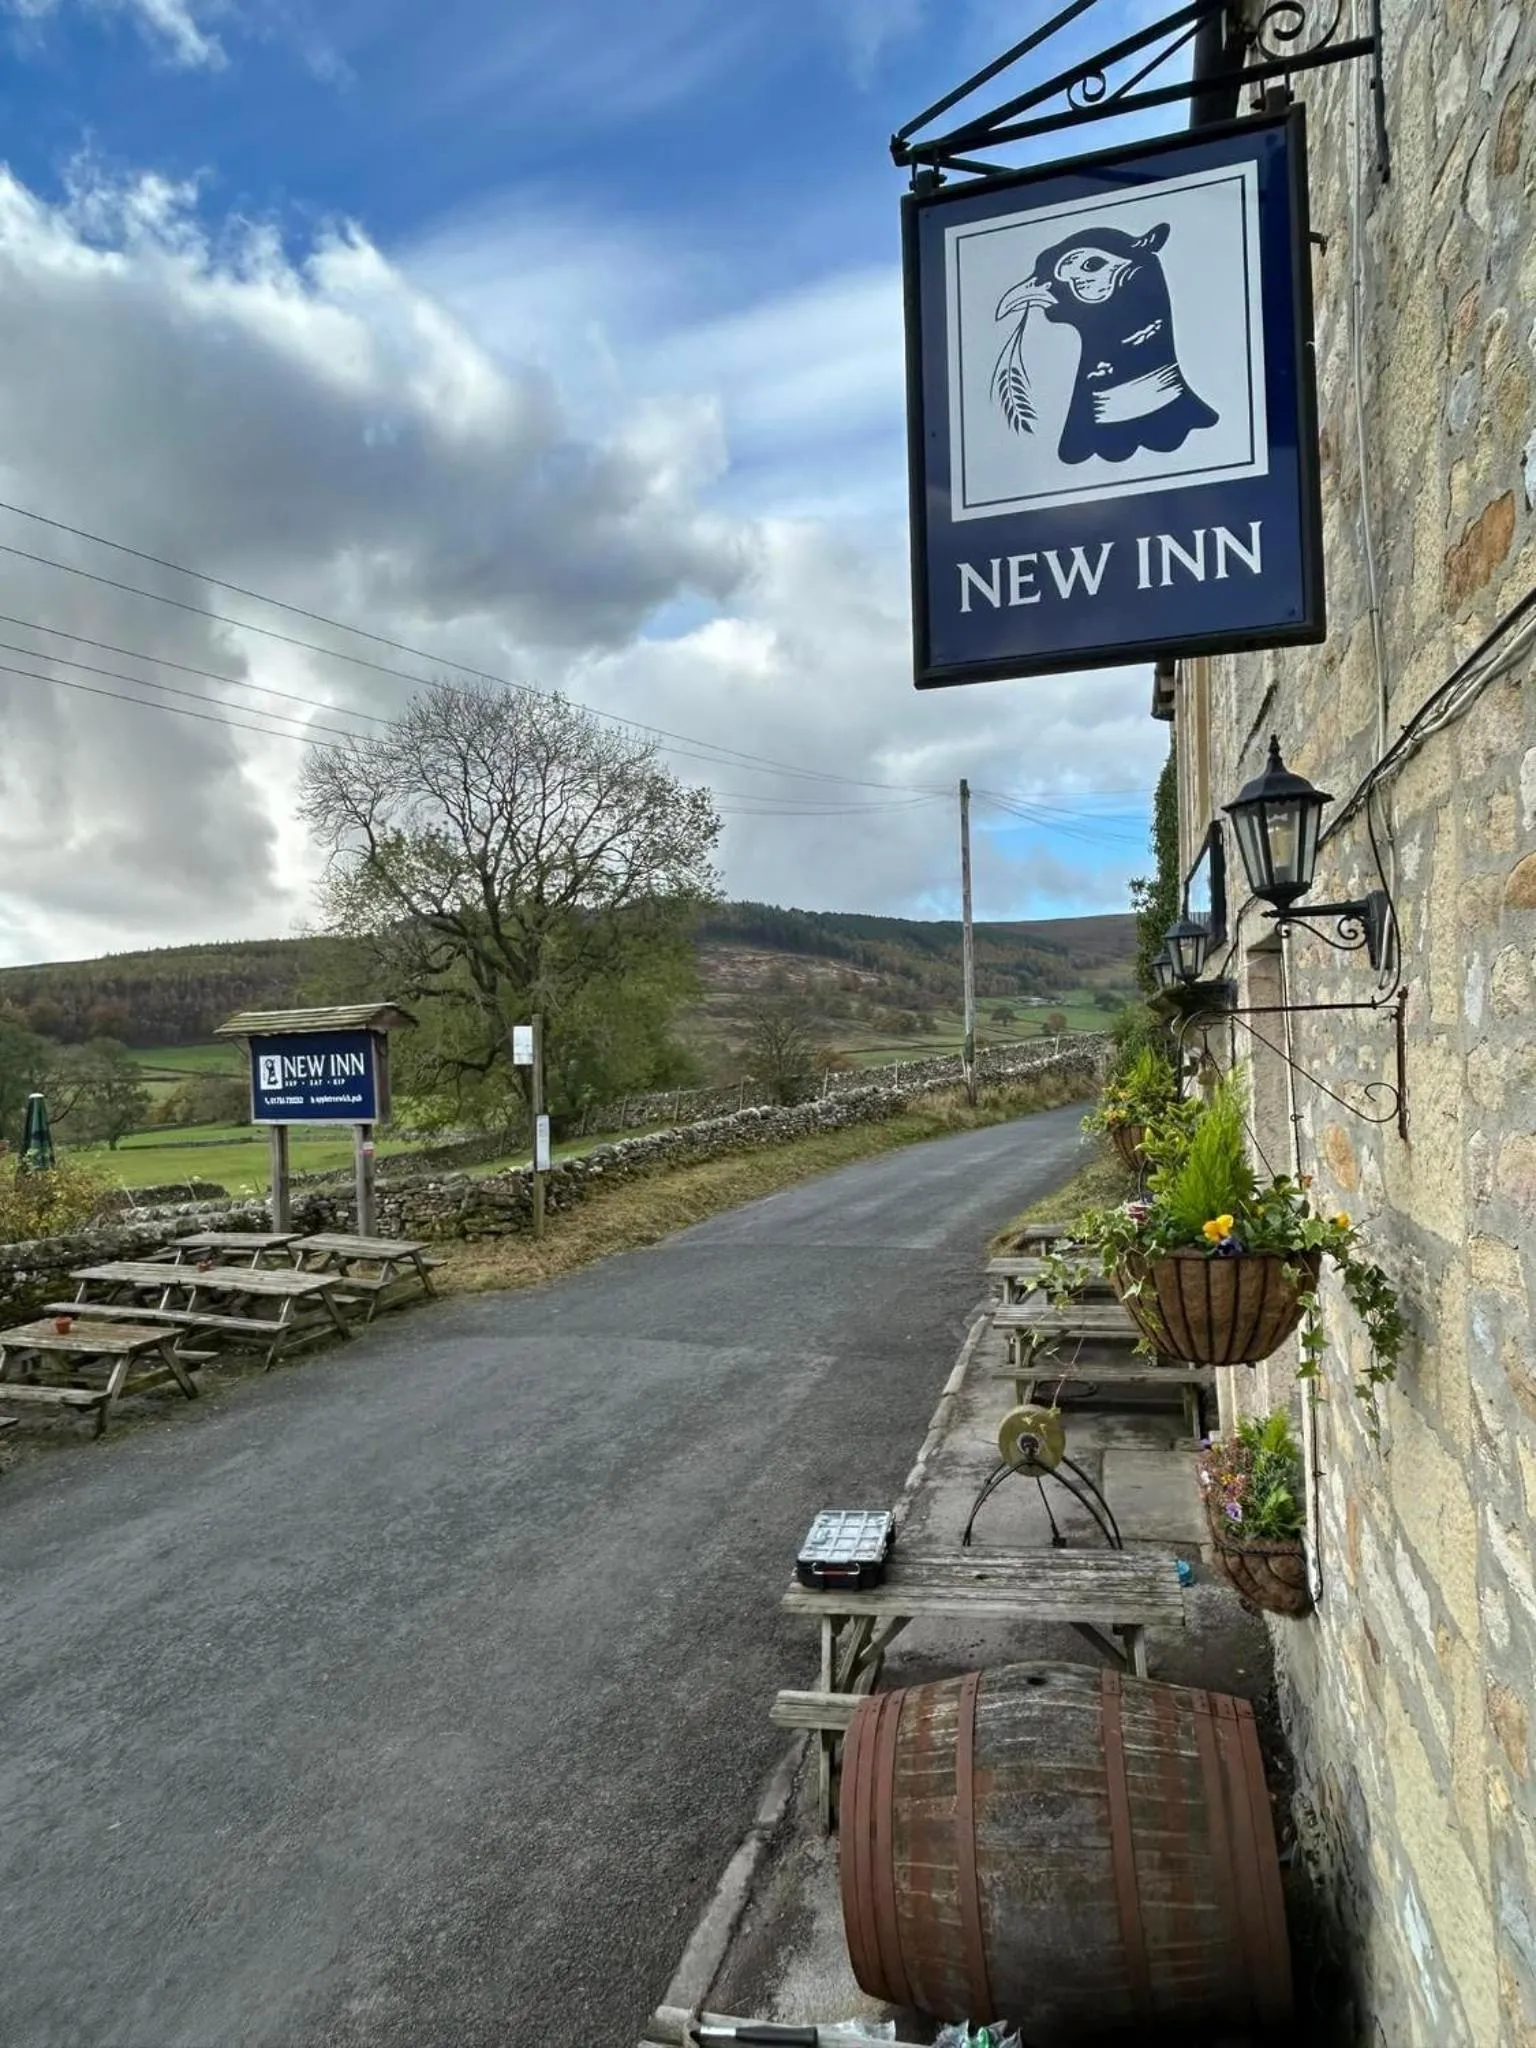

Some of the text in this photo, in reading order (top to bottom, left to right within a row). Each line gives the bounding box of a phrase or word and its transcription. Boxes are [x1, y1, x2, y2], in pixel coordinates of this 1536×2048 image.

[956, 521, 1264, 613] NEW INN
[283, 1052, 365, 1078] NEW INN
